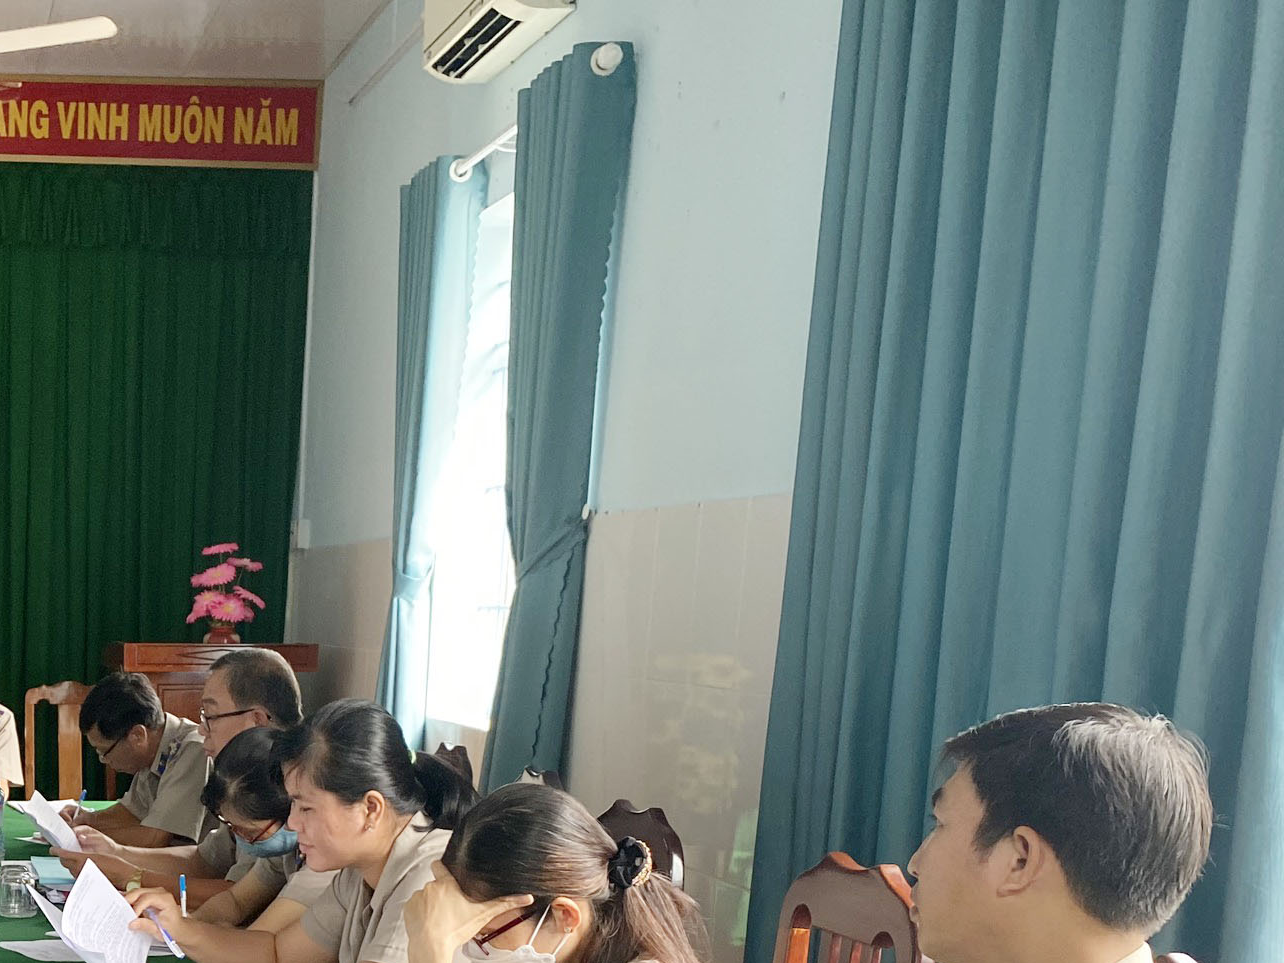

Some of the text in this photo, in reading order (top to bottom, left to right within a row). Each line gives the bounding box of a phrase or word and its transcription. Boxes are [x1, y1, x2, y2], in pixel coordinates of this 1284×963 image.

[57, 102, 129, 141] VINH
[138, 95, 224, 144] MUÔN
[233, 97, 298, 145] NĂM
